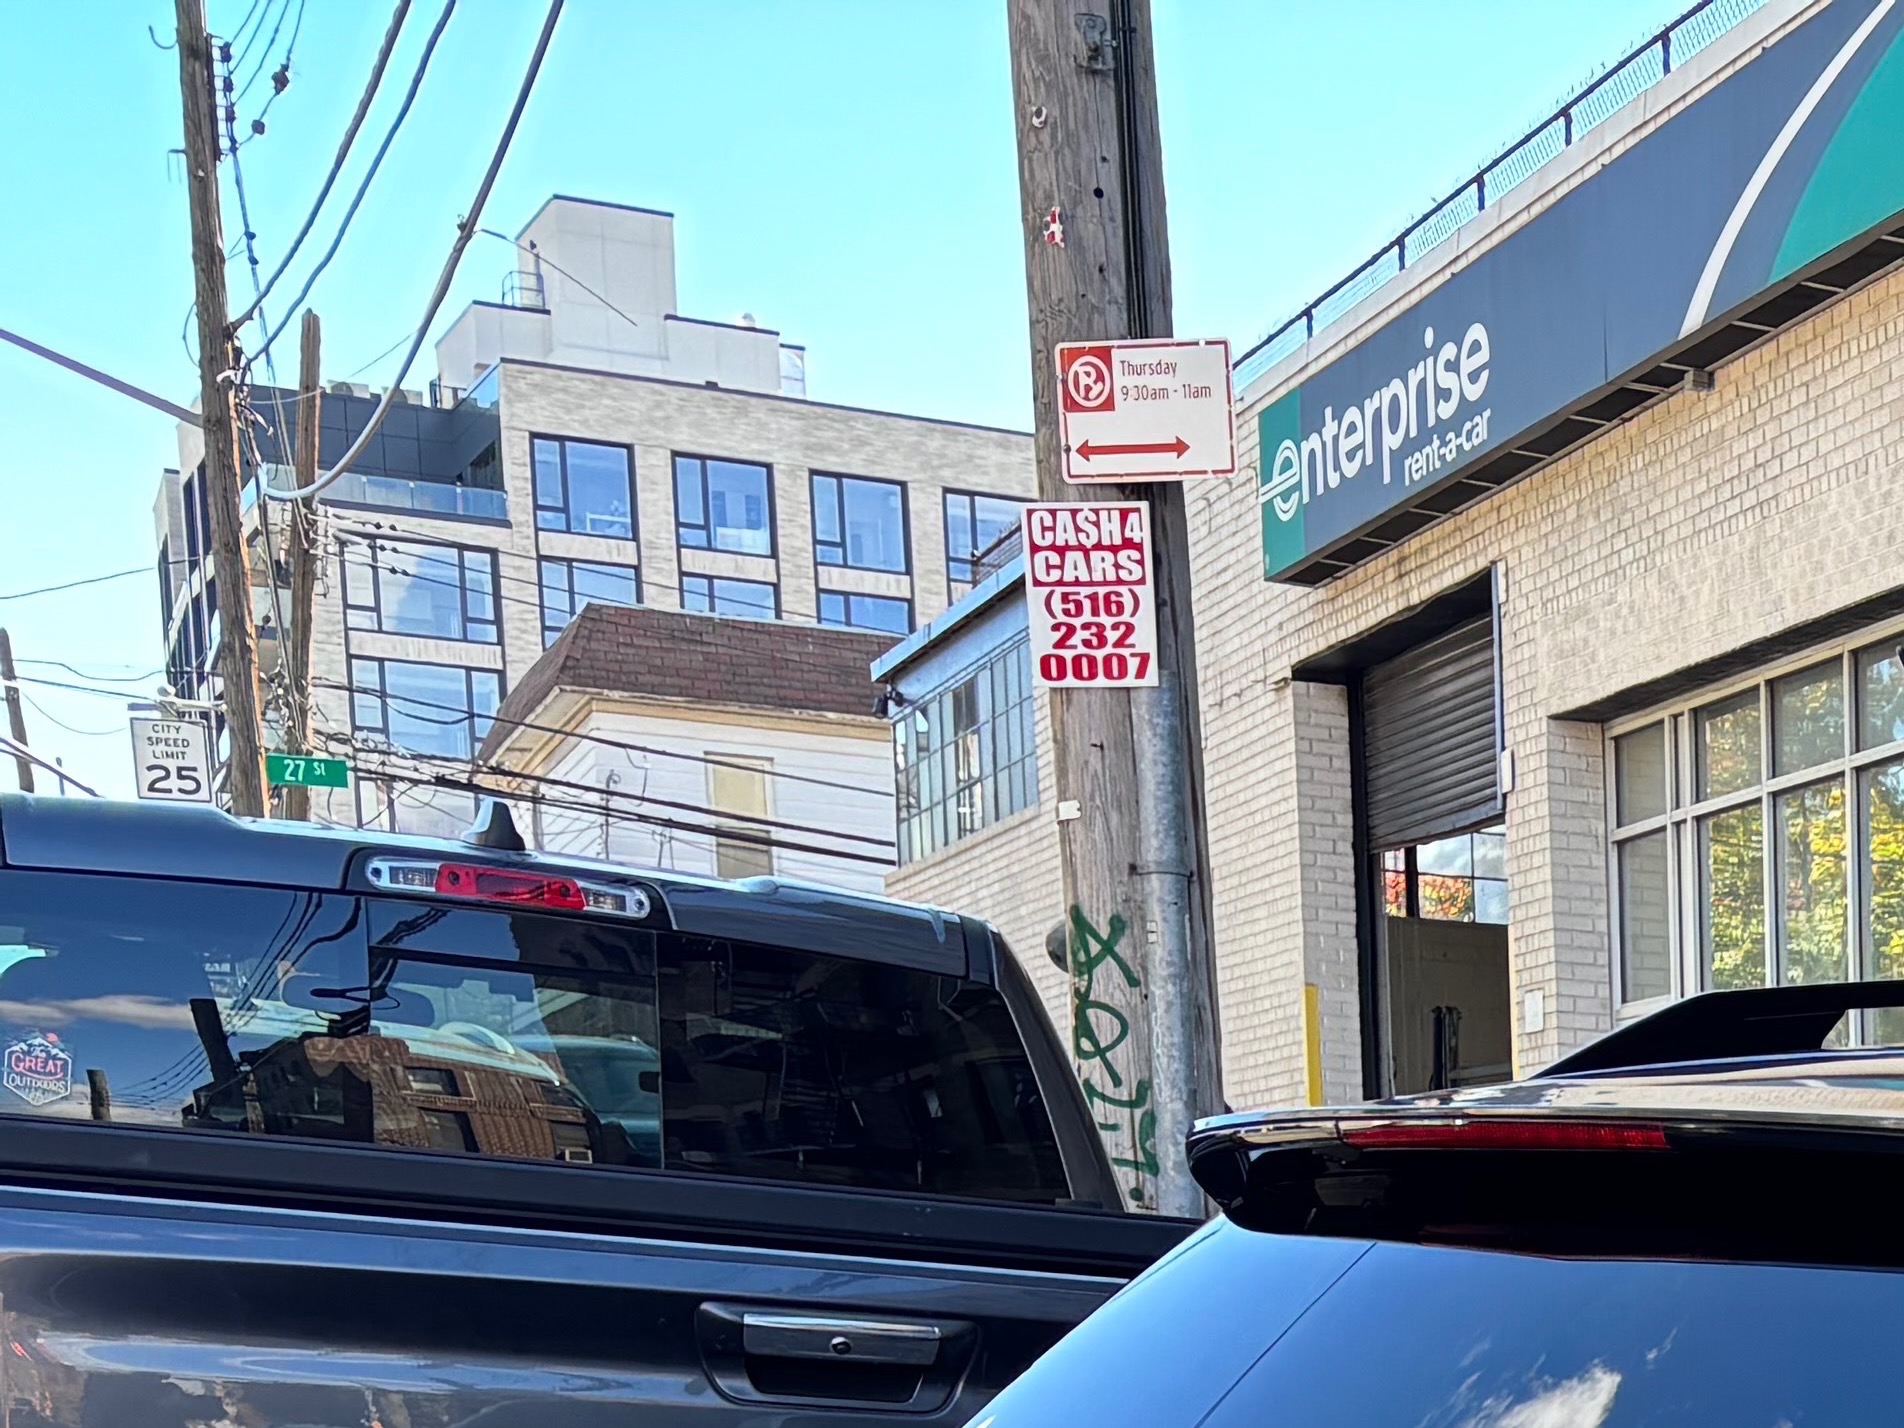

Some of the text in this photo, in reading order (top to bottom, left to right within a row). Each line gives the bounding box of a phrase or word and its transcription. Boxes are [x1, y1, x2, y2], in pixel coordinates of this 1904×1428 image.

[1119, 359, 1177, 378] Thursday
[1120, 385, 1169, 402] 9:30am
[1182, 383, 1212, 399] 11am
[1260, 322, 1490, 522] enterprise
[1404, 408, 1491, 487] rent-a-car
[1033, 549, 1143, 583] CARS
[1044, 588, 1140, 620] (516)
[1050, 621, 1136, 650] 232
[1039, 652, 1150, 681] 0007
[151, 723, 182, 734] CITY
[146, 736, 190, 748] SPEED
[152, 750, 186, 761] LIMIT
[146, 764, 202, 795] 25
[284, 759, 306, 781] 27
[12, 1052, 64, 1074] GREAT
